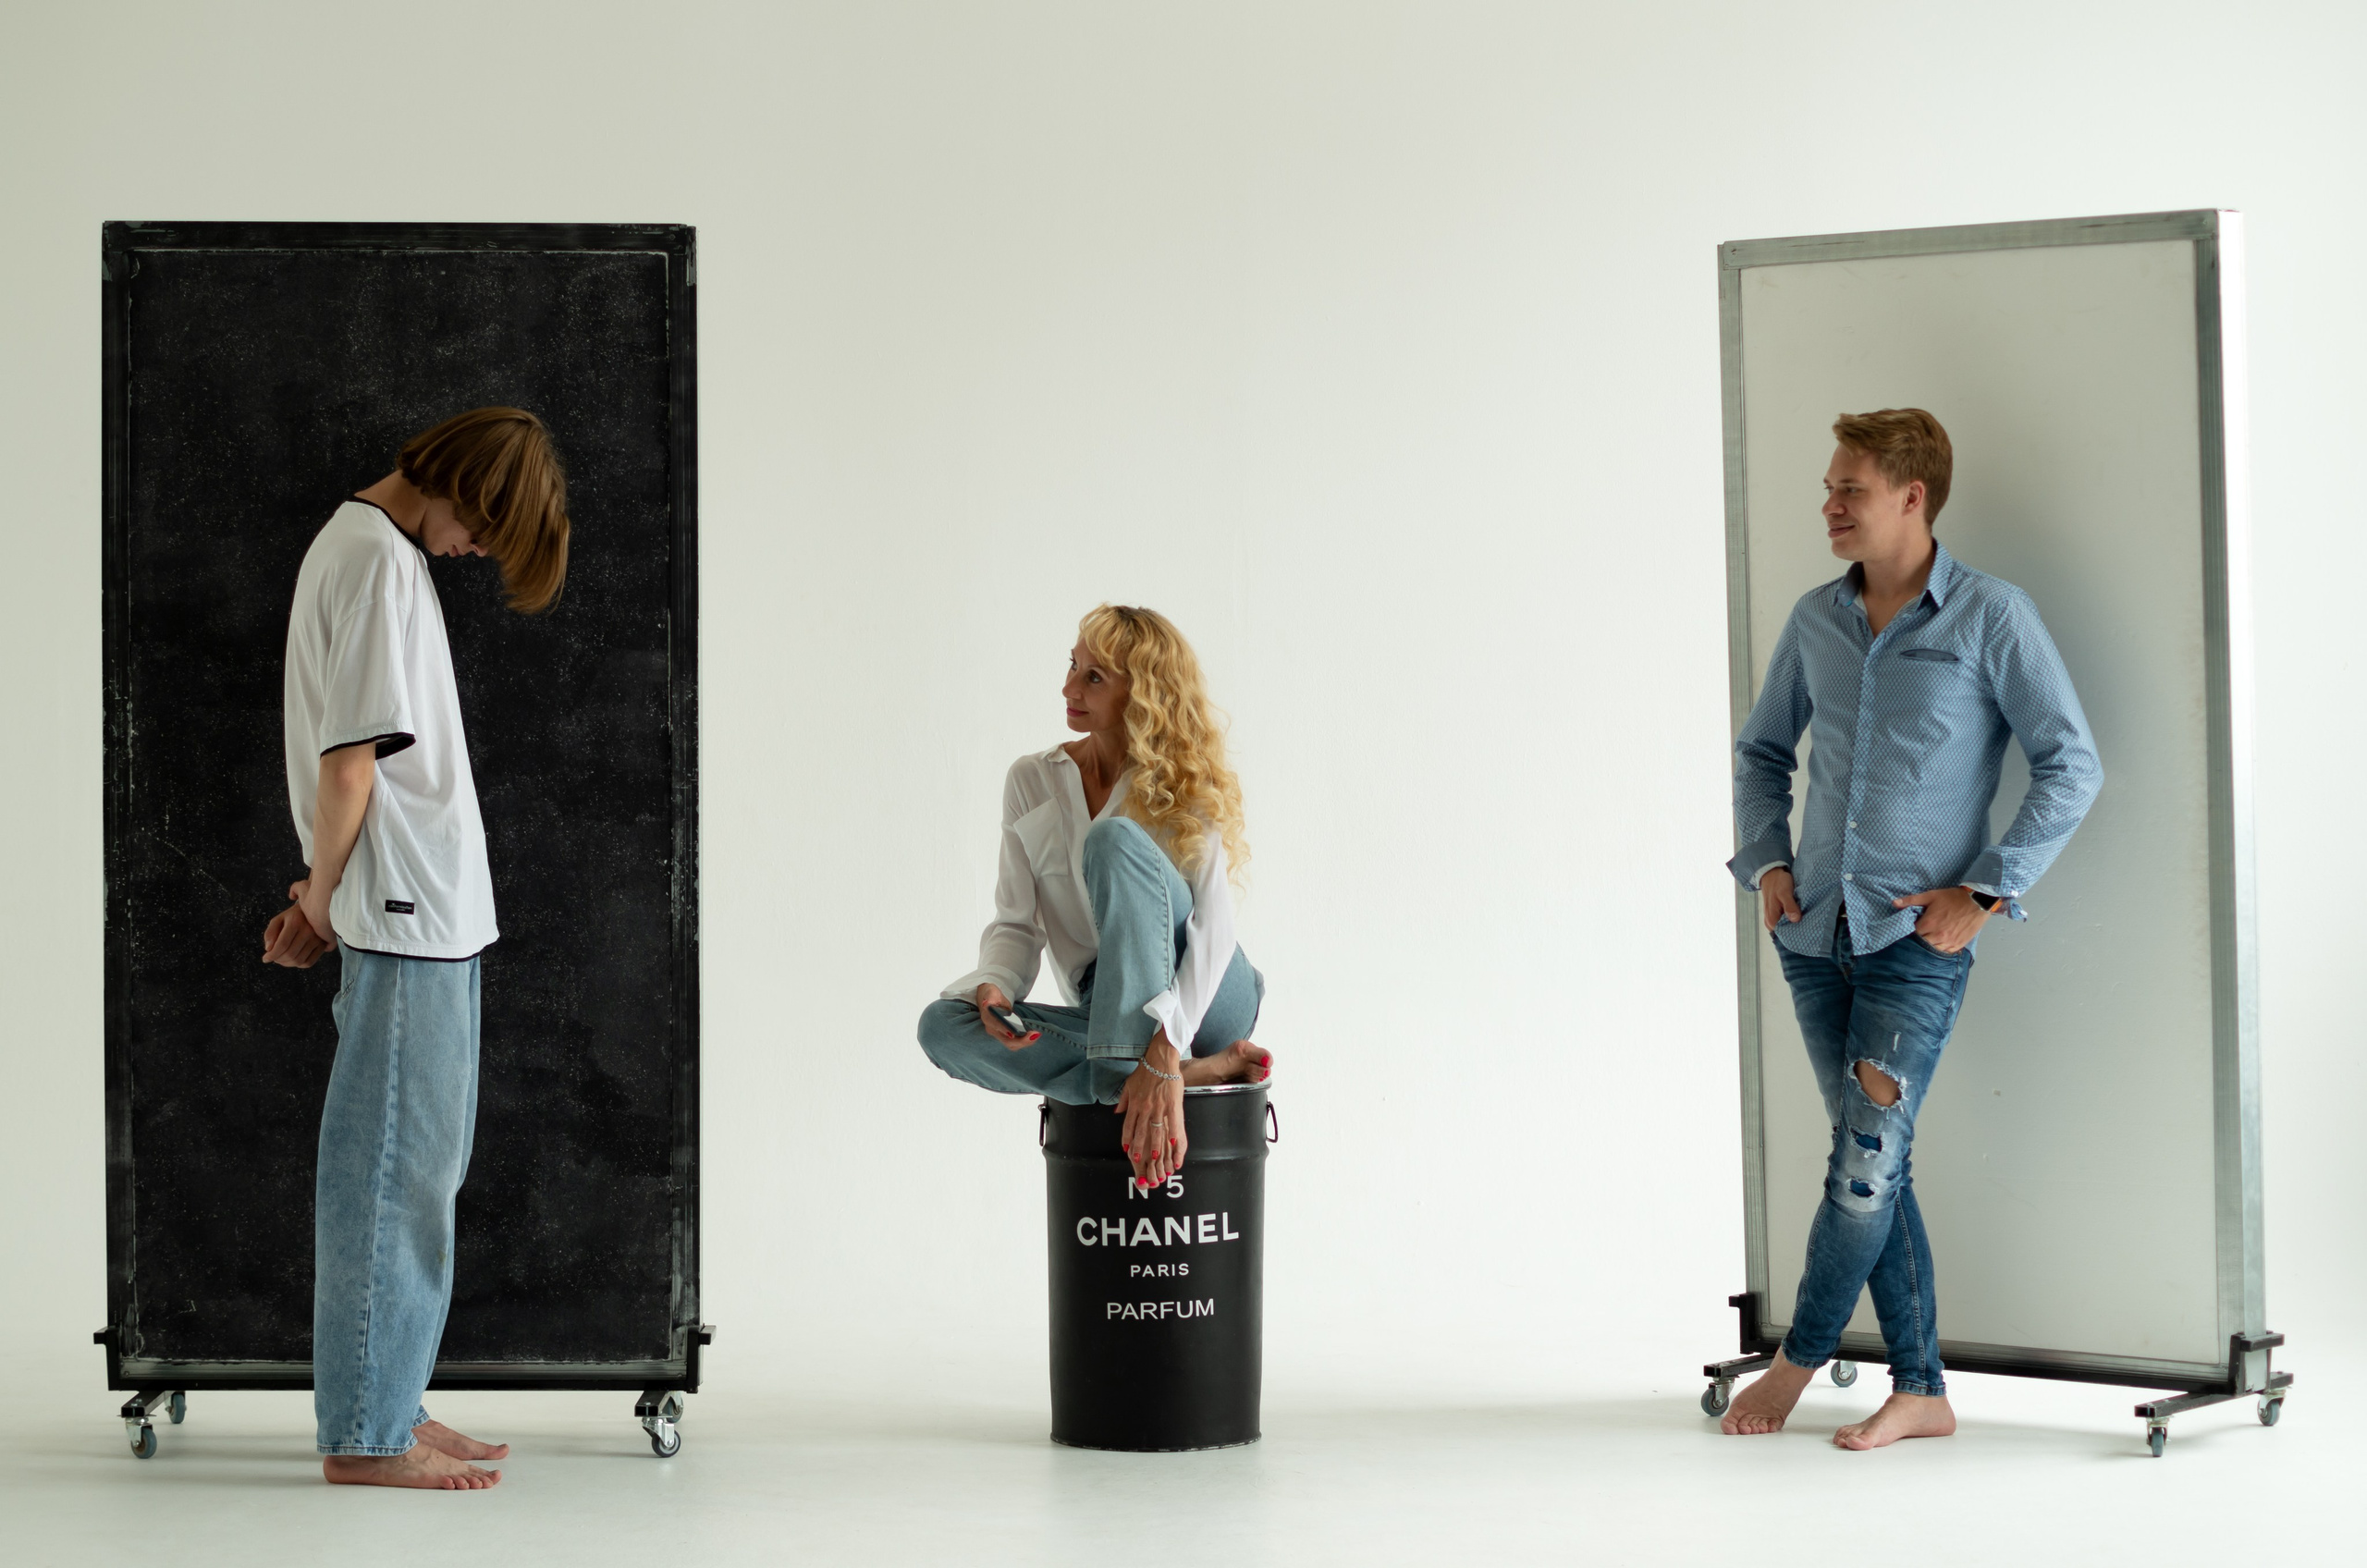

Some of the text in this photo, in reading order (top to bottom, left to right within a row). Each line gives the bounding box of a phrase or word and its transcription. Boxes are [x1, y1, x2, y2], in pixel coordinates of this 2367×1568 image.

[1166, 1175, 1184, 1198] 5
[1076, 1212, 1240, 1246] CHANEL
[1130, 1263, 1190, 1278] PARIS
[1107, 1298, 1215, 1320] PARFUM
